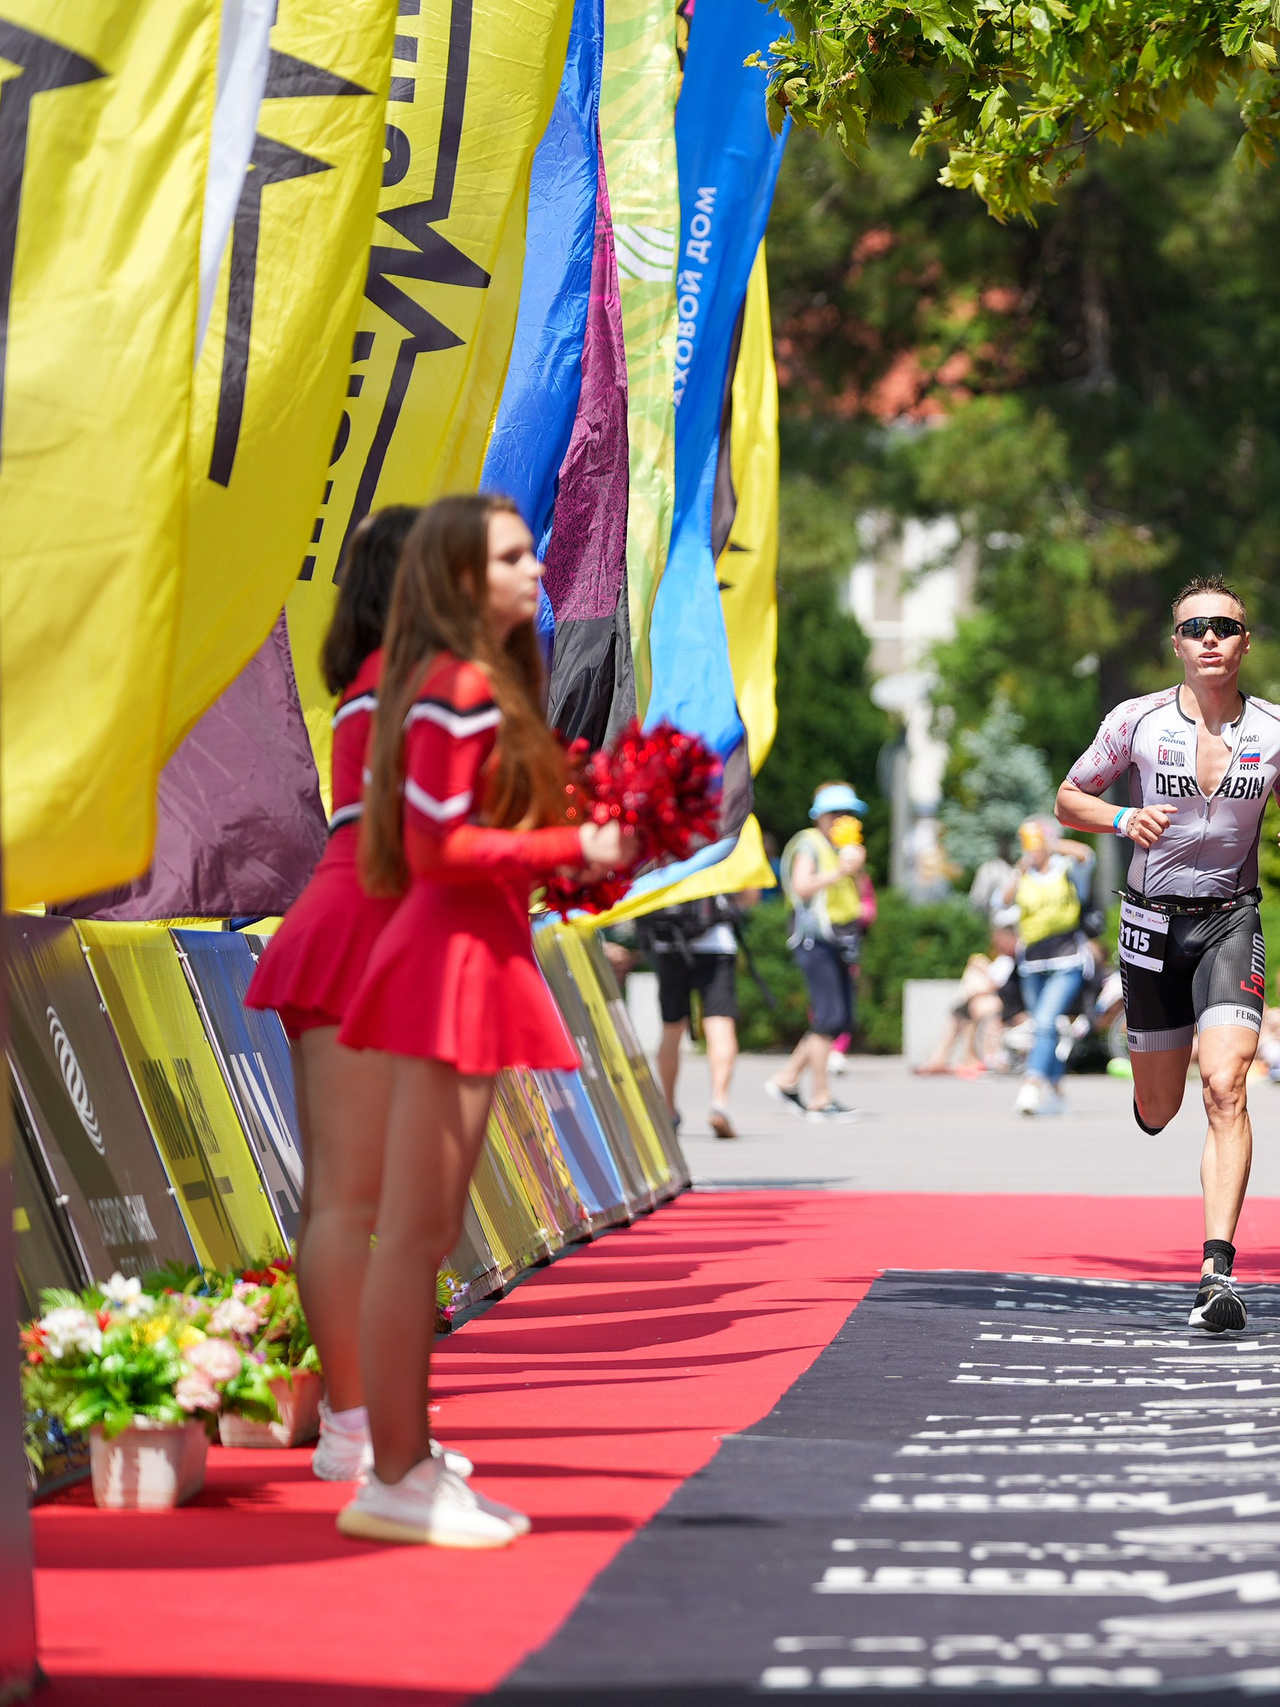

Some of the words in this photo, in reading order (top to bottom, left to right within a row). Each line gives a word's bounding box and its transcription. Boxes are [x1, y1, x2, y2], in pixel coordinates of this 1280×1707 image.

[686, 187, 717, 264] ДОМ
[1120, 921, 1150, 952] 3115
[979, 1333, 1191, 1347] IRON
